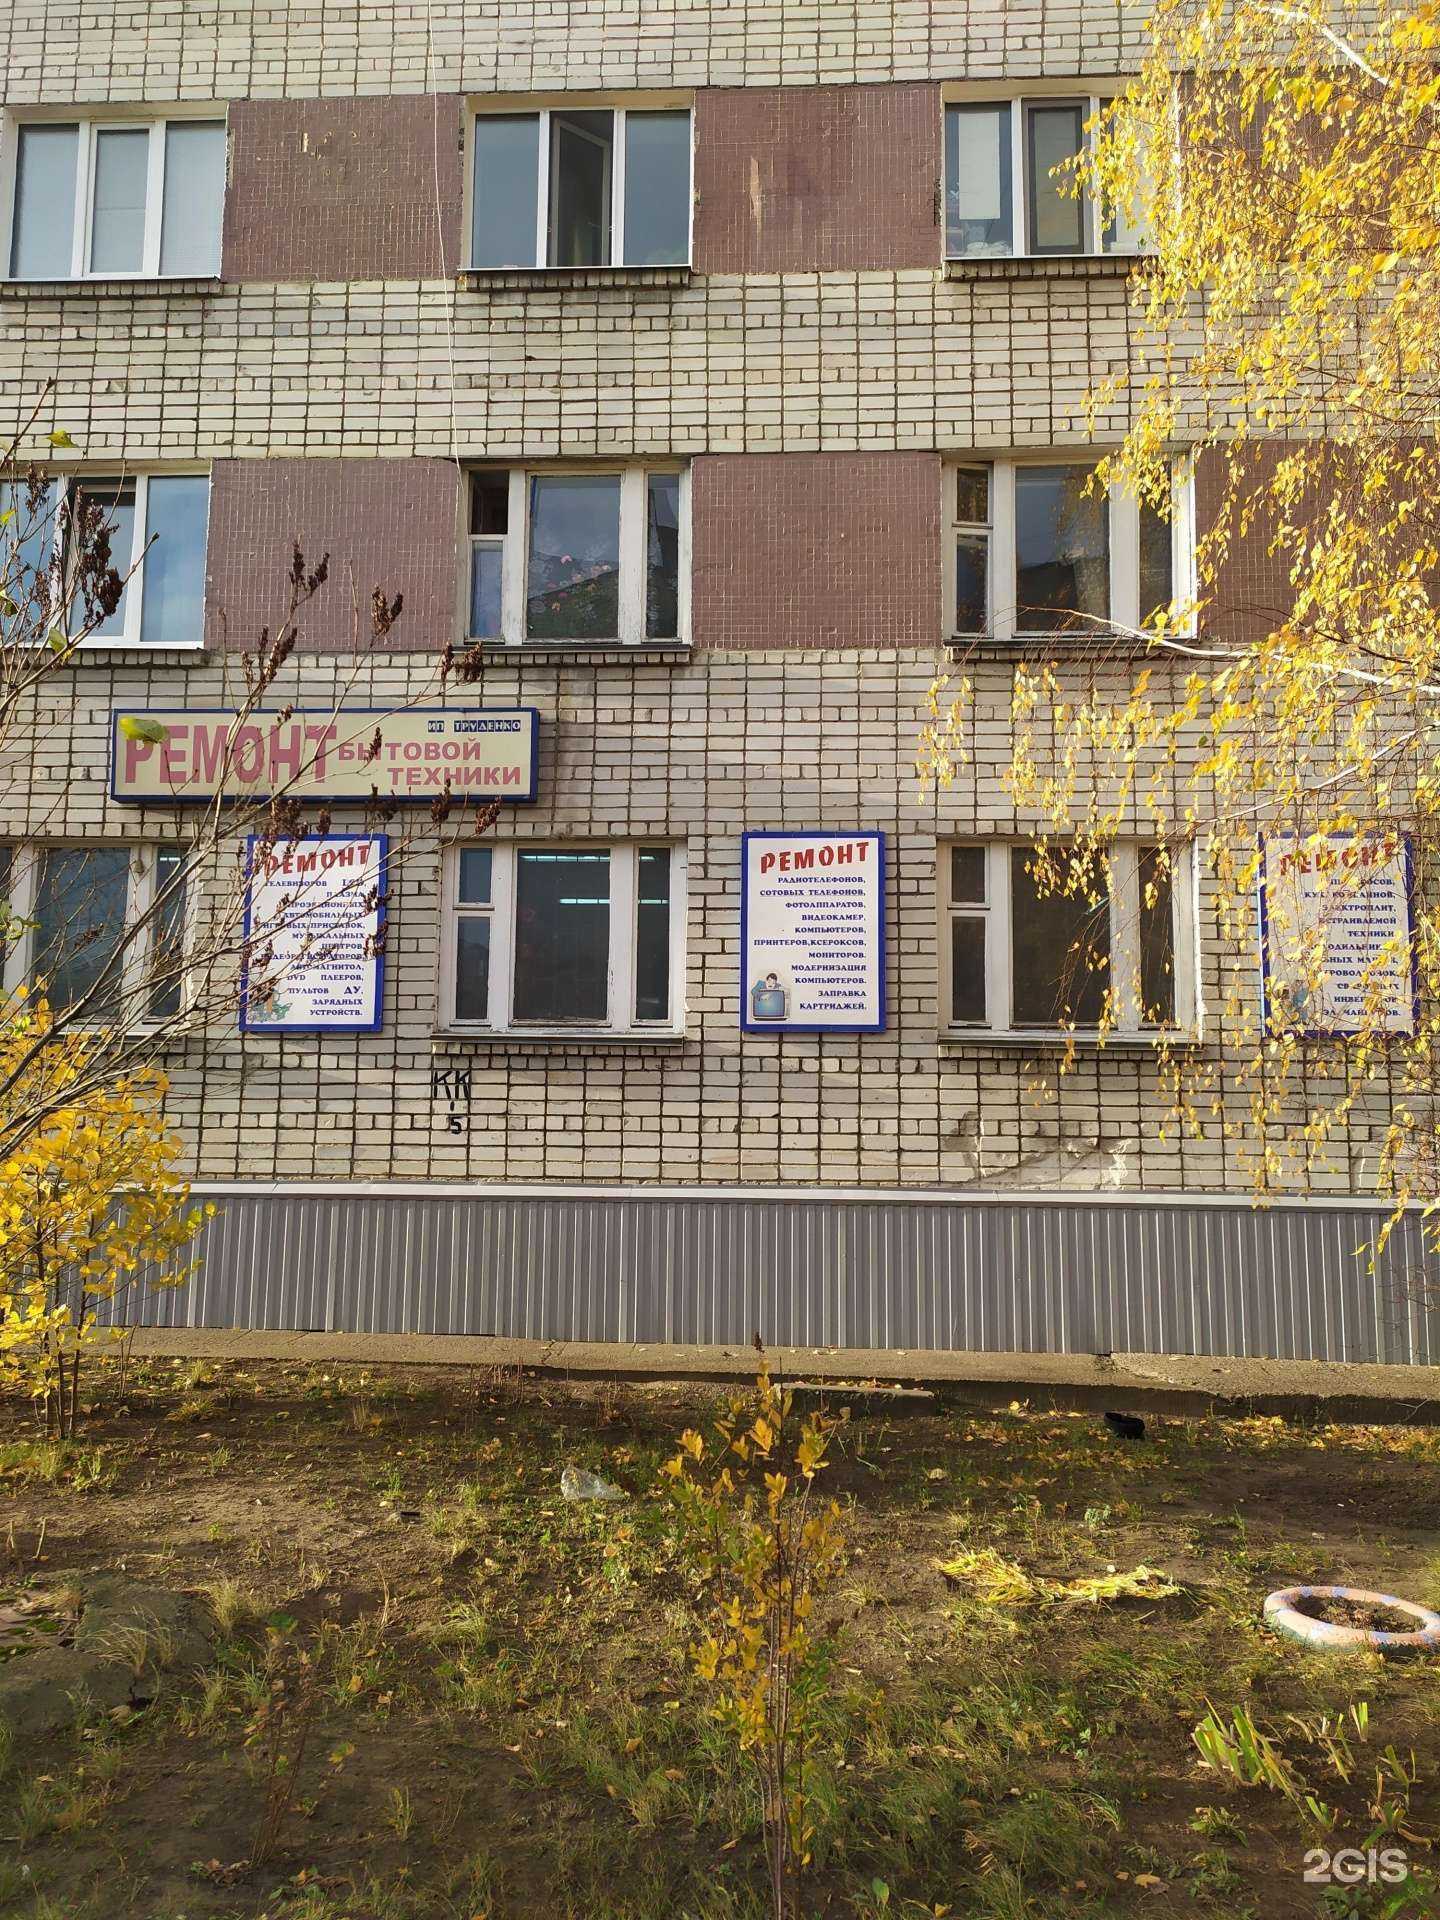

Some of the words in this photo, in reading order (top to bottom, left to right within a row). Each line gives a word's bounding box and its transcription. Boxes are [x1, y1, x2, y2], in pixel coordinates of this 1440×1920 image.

[428, 720, 445, 733] ИП
[453, 720, 521, 733] ТРУДЕНКО
[125, 725, 337, 784] РЕМОНТ
[338, 737, 481, 761] БЫТОВОЙ
[387, 766, 521, 786] ТЕХНИКИ
[261, 844, 371, 879] РЕМОНТ
[760, 841, 870, 874] РЕМОНТ
[791, 964, 867, 972] МОДЕРНИЗАЦИЯ
[312, 998, 363, 1006] ЗАРЯДНЫХ
